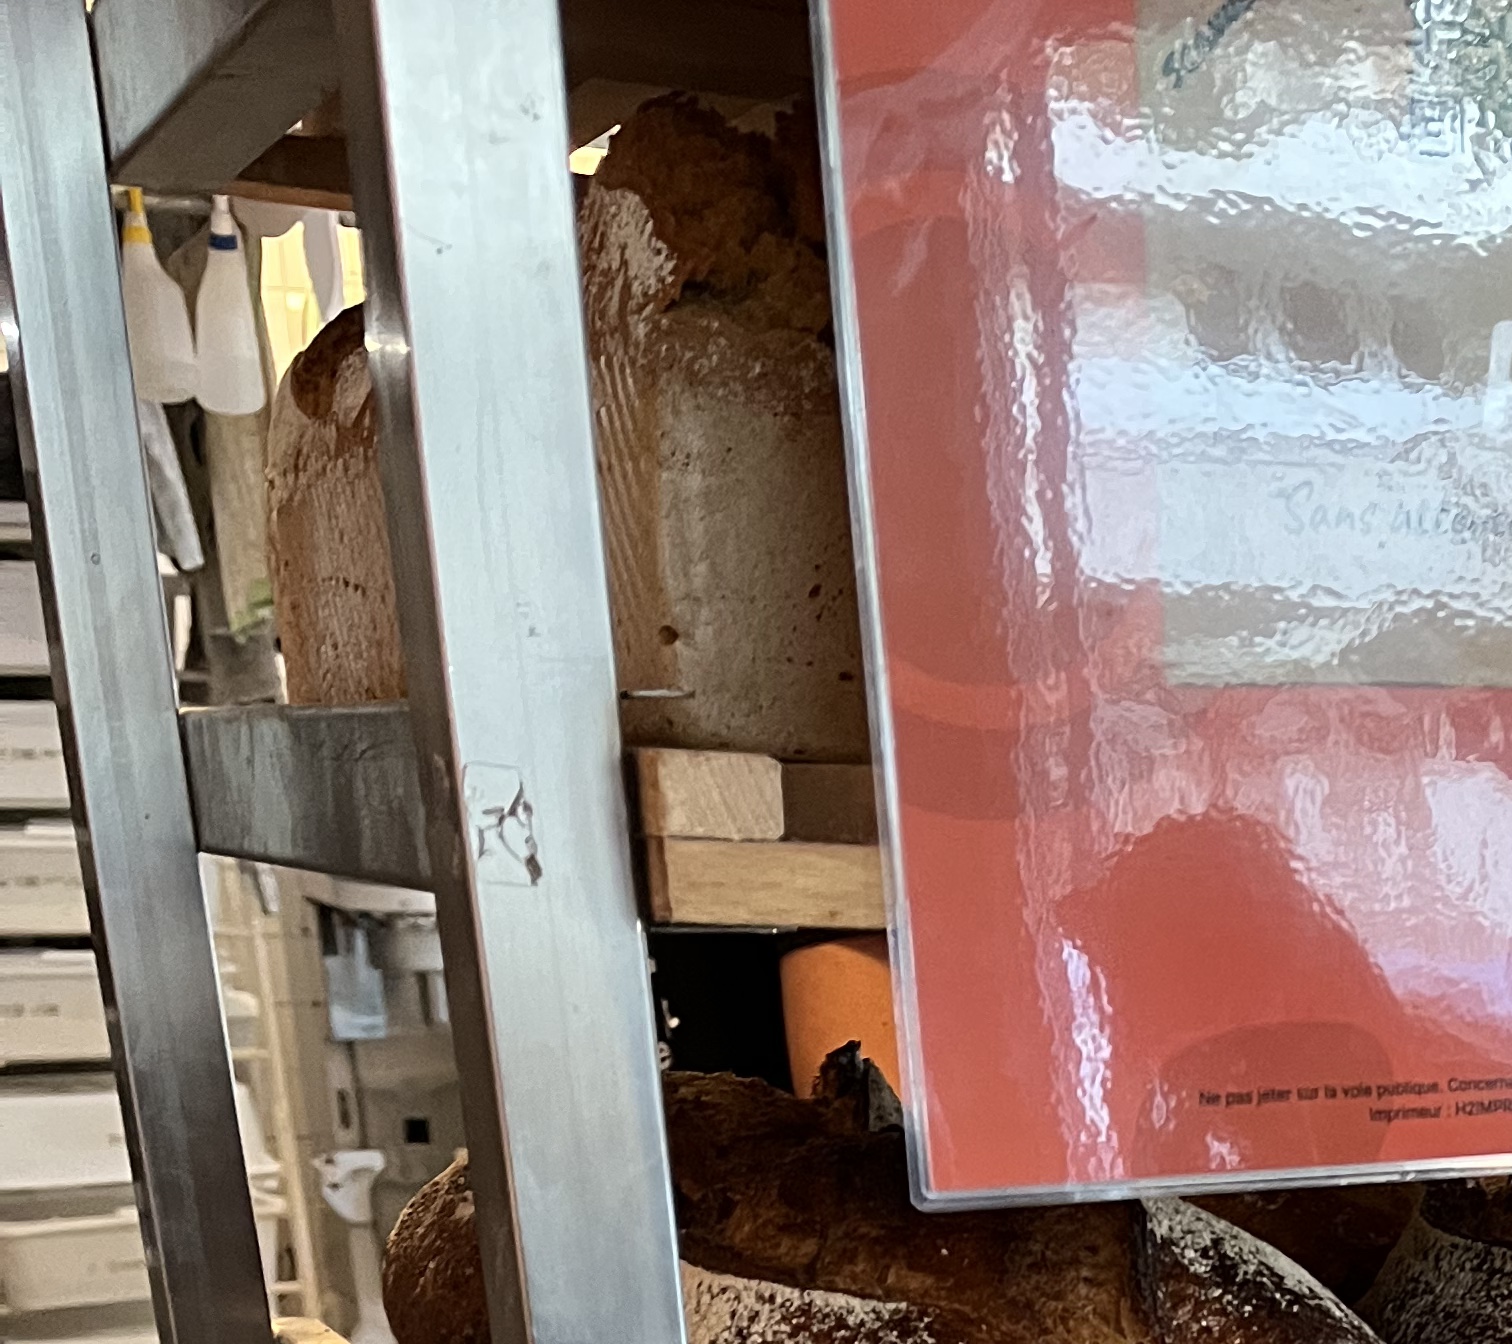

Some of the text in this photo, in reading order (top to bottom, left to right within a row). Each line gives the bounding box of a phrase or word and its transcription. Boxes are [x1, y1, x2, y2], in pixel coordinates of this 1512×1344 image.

[1225, 1091, 1253, 1107] pas
[1257, 1087, 1292, 1106] jeter
[1324, 1084, 1337, 1099] la
[1342, 1082, 1372, 1099] voie
[1369, 1106, 1442, 1124] Imprimeur
